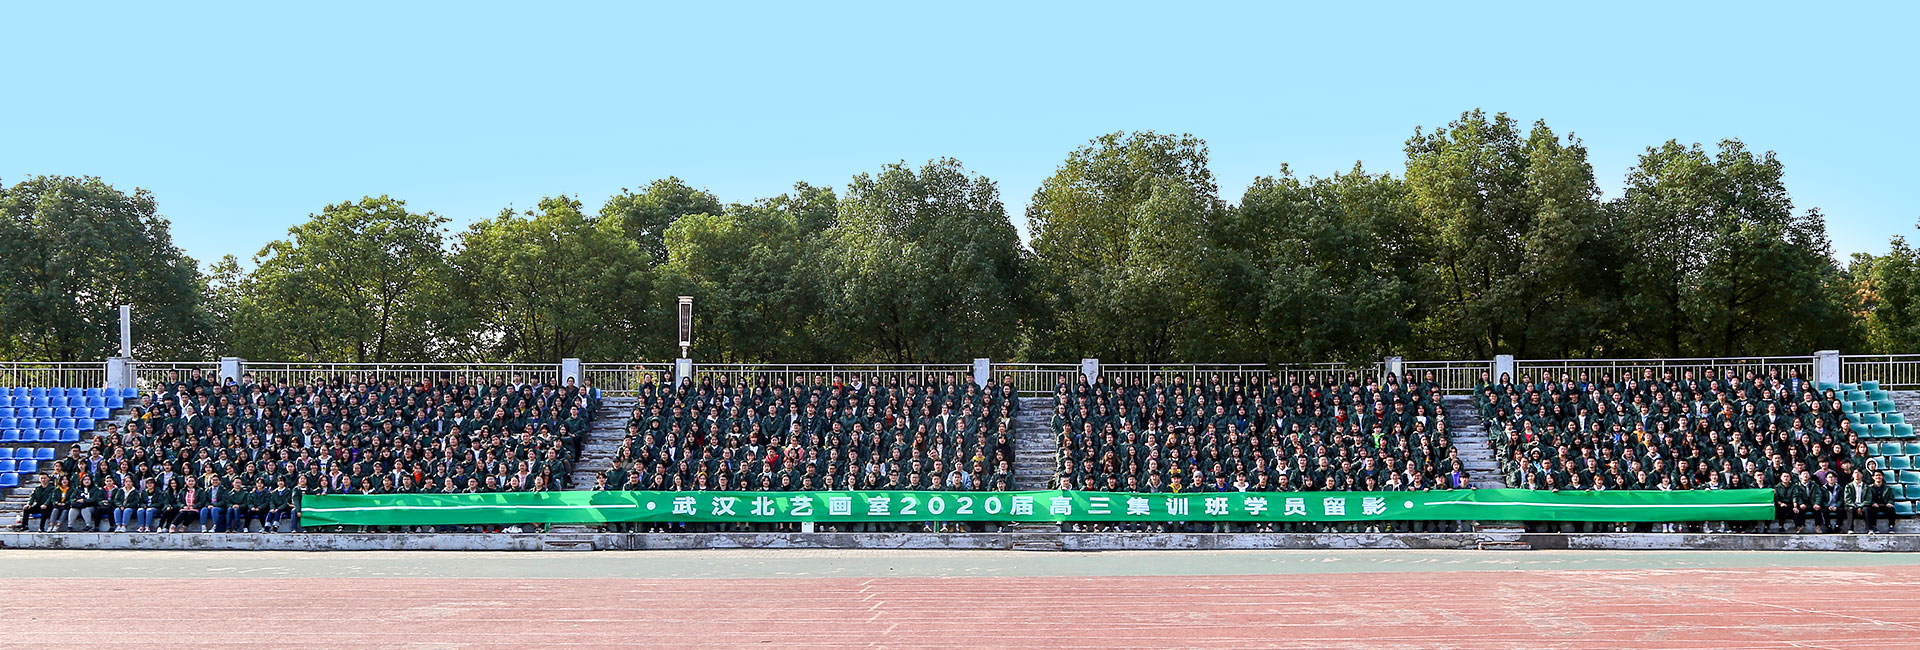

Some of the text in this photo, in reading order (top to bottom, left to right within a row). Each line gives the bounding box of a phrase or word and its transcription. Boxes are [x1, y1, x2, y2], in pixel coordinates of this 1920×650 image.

[672, 496, 1387, 516] 武汉北艺画室2020届高三集训班学员留影
